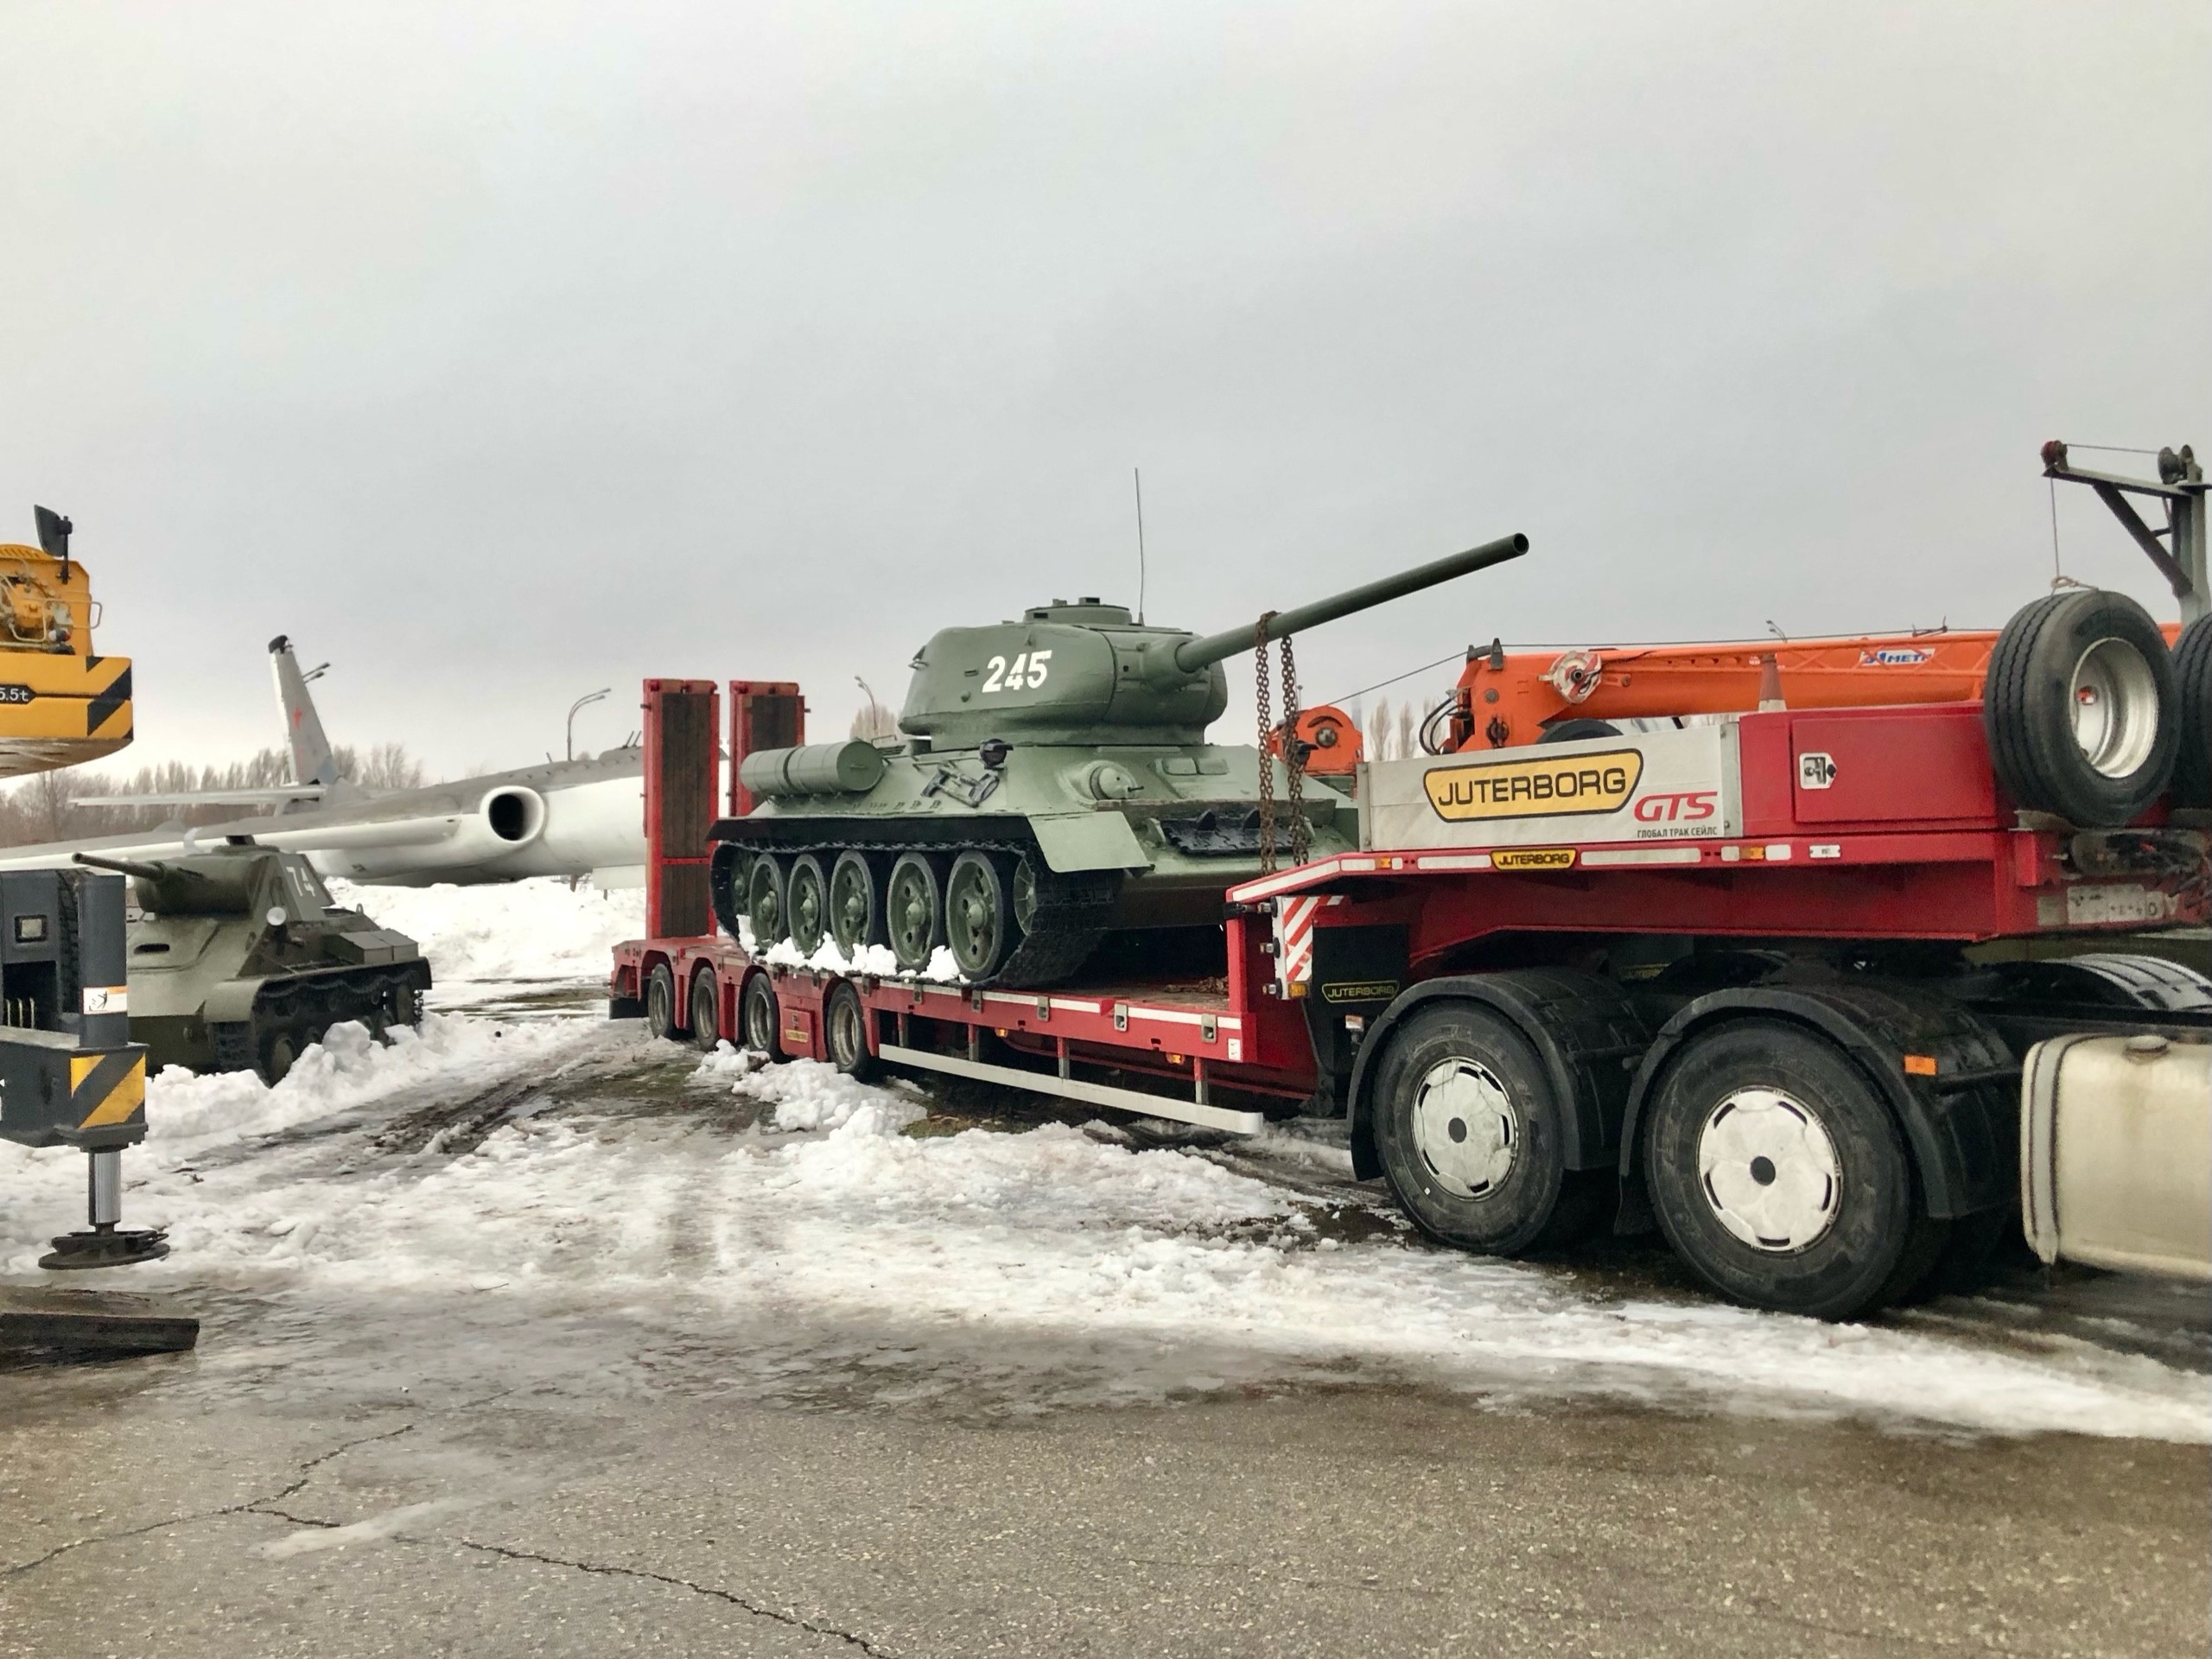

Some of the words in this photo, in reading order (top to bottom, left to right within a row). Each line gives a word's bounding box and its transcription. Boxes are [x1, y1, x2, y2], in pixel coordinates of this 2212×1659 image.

[982, 650, 1052, 693] 245
[1438, 767, 1626, 806] JUTERBORG
[1634, 791, 1718, 822] GTS
[1637, 829, 1668, 839] ГЛОБАЛ
[1669, 827, 1690, 837] ТРАК
[1691, 824, 1718, 836] СЕЙЛС
[1498, 853, 1570, 866] JUTERBORG
[286, 866, 315, 897] 74
